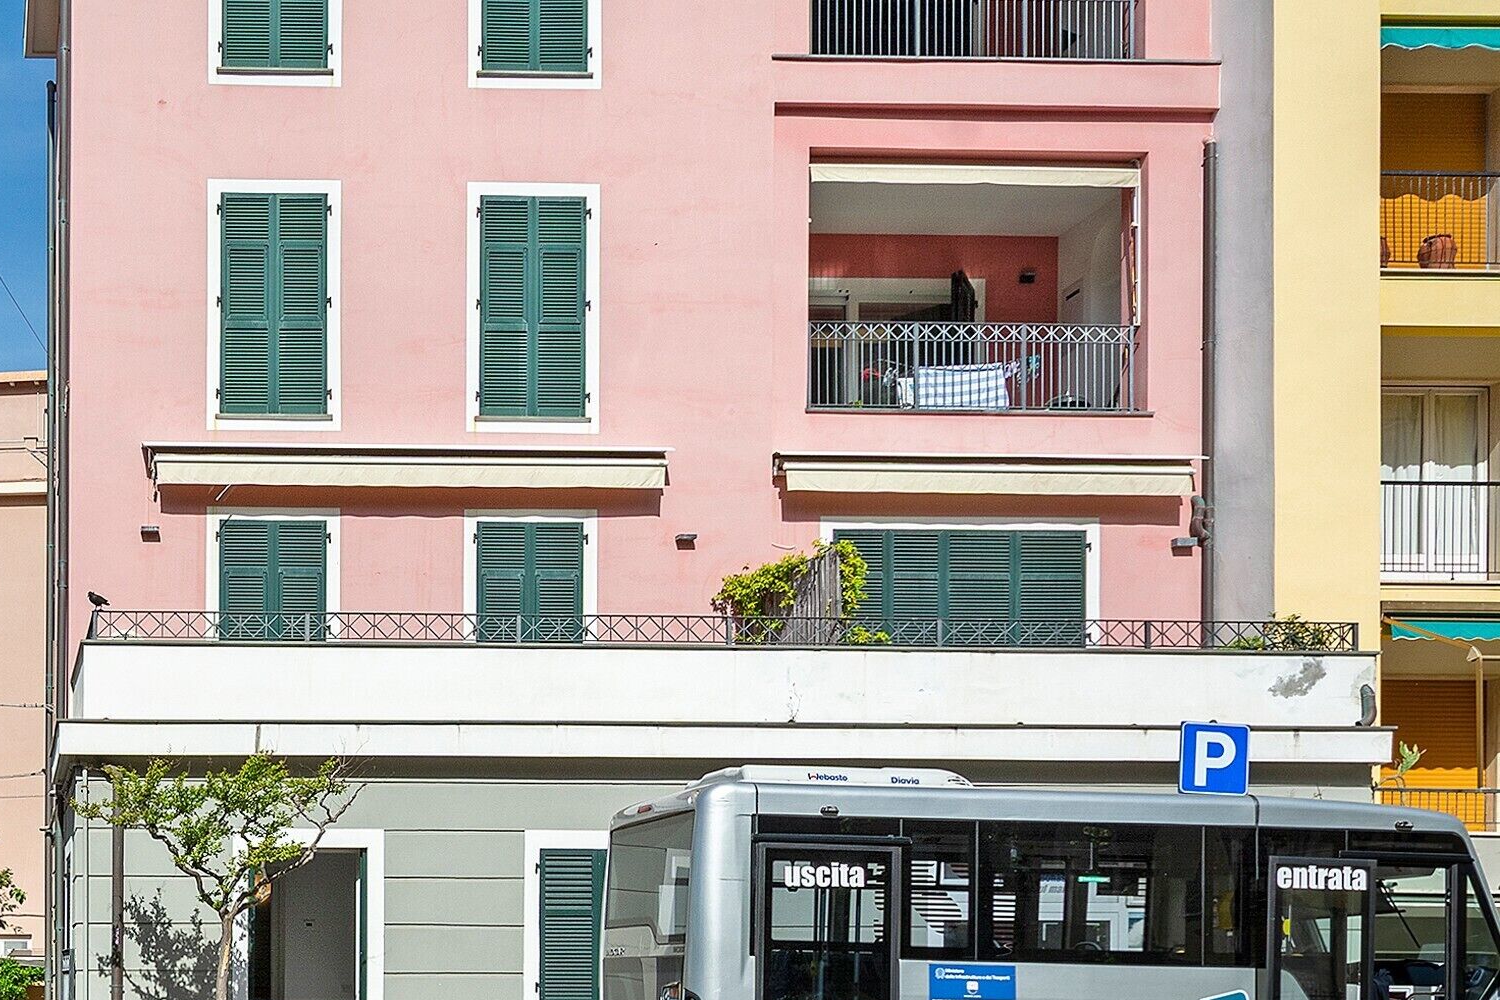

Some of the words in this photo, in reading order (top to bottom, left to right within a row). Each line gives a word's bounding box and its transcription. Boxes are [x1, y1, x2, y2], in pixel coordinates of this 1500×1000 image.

[1194, 730, 1237, 787] P
[807, 773, 848, 782] Webasto
[891, 776, 920, 785] Diavia
[784, 861, 865, 888] uscita
[1276, 865, 1367, 891] entrata
